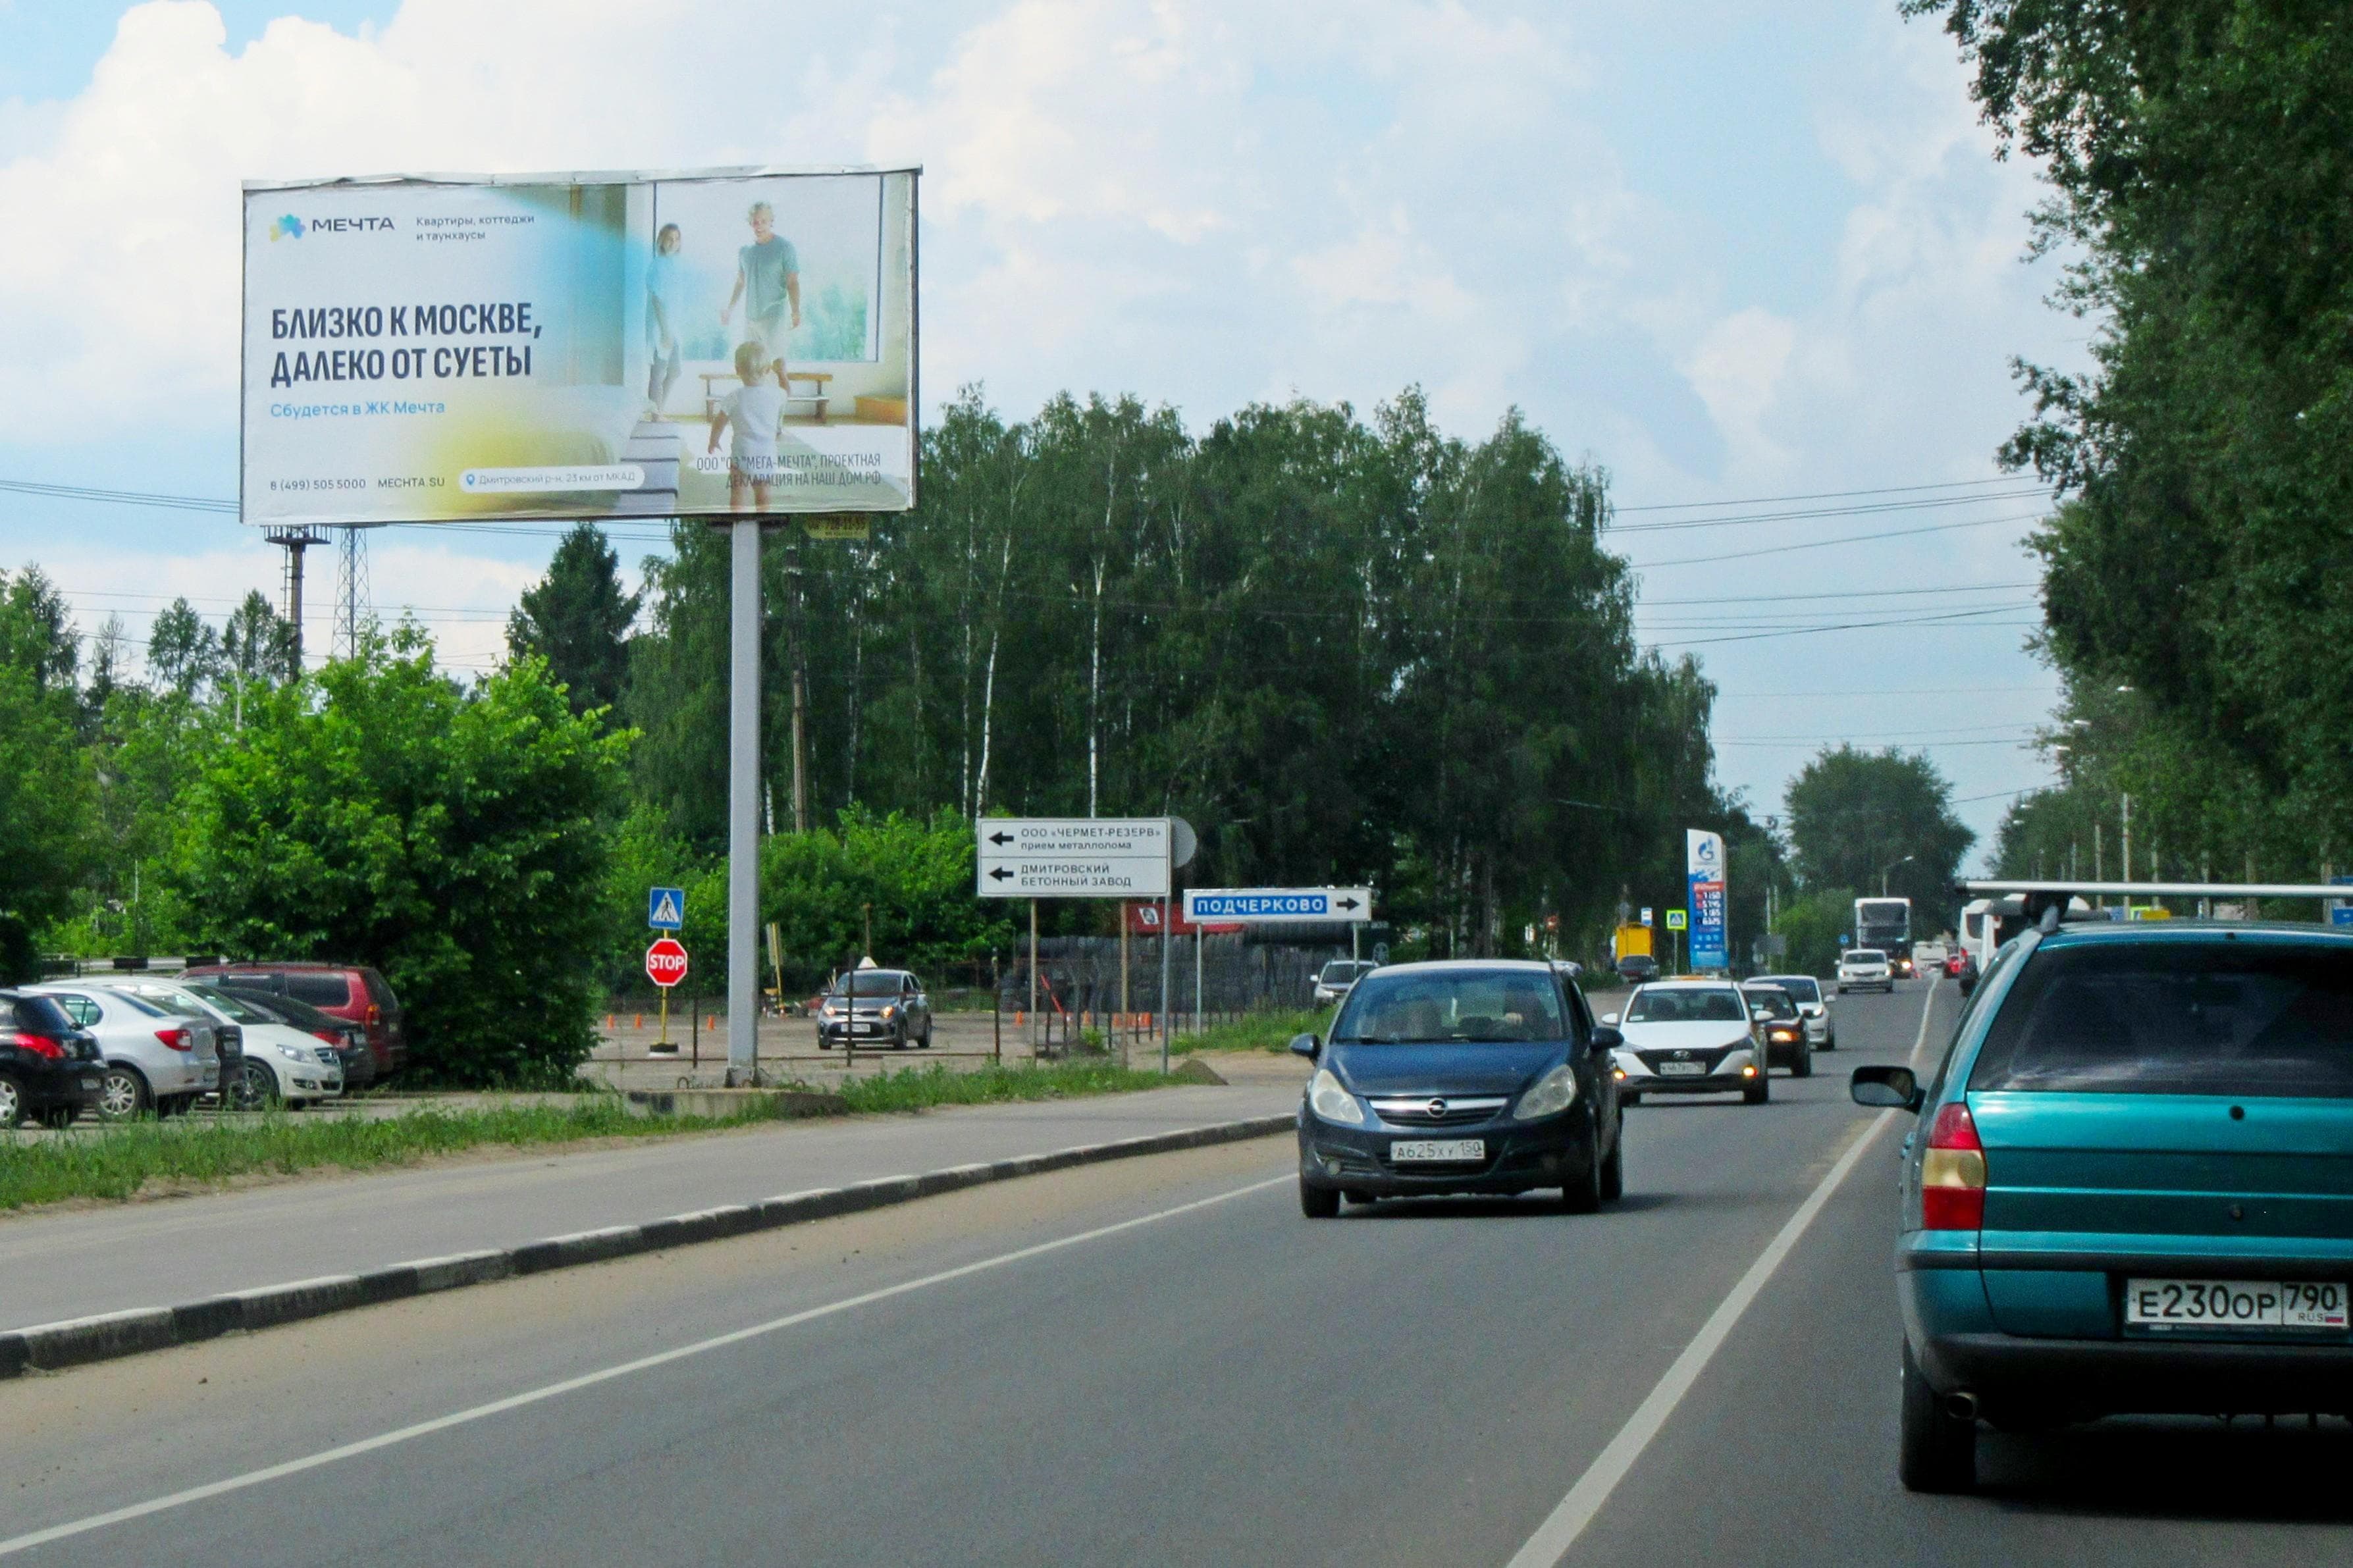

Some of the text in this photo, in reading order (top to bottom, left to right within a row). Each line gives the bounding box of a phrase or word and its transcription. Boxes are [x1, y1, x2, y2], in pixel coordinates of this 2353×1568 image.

[312, 217, 395, 232] МЕЧТА
[416, 215, 535, 228] Квартиры, коттеджи
[427, 232, 486, 242] таунхаусы
[272, 303, 541, 338] БЛИЗКО К МОСКВЕ,
[271, 346, 531, 388] ДАЛЕКО ОТ СУЕТЫ
[271, 401, 445, 420] Сбудется в ЖК Мечта
[697, 457, 719, 470] ООО
[820, 453, 881, 467] ПРОЕКТНАЯ
[271, 479, 366, 491] 8 (499) 505 5000
[378, 477, 445, 488] MECHTA.SU
[479, 474, 543, 486] Дмитровский
[606, 472, 635, 481] МКАД
[726, 473, 793, 489] ДЕКЛАРАЦИЯ
[795, 473, 809, 485] НА
[1021, 828, 1047, 837] ООО
[1021, 841, 1132, 850] прием металлолома
[1021, 863, 1110, 874] ДМИТРОВСКИЙ
[1021, 875, 1132, 887] БЕТОННЫЙ ЗАВОД
[1197, 899, 1324, 914] ПОДЧЕРКОВО
[649, 955, 685, 971] STOP
[2284, 1284, 2338, 1311] 790
[2298, 1312, 2324, 1322] RUS
